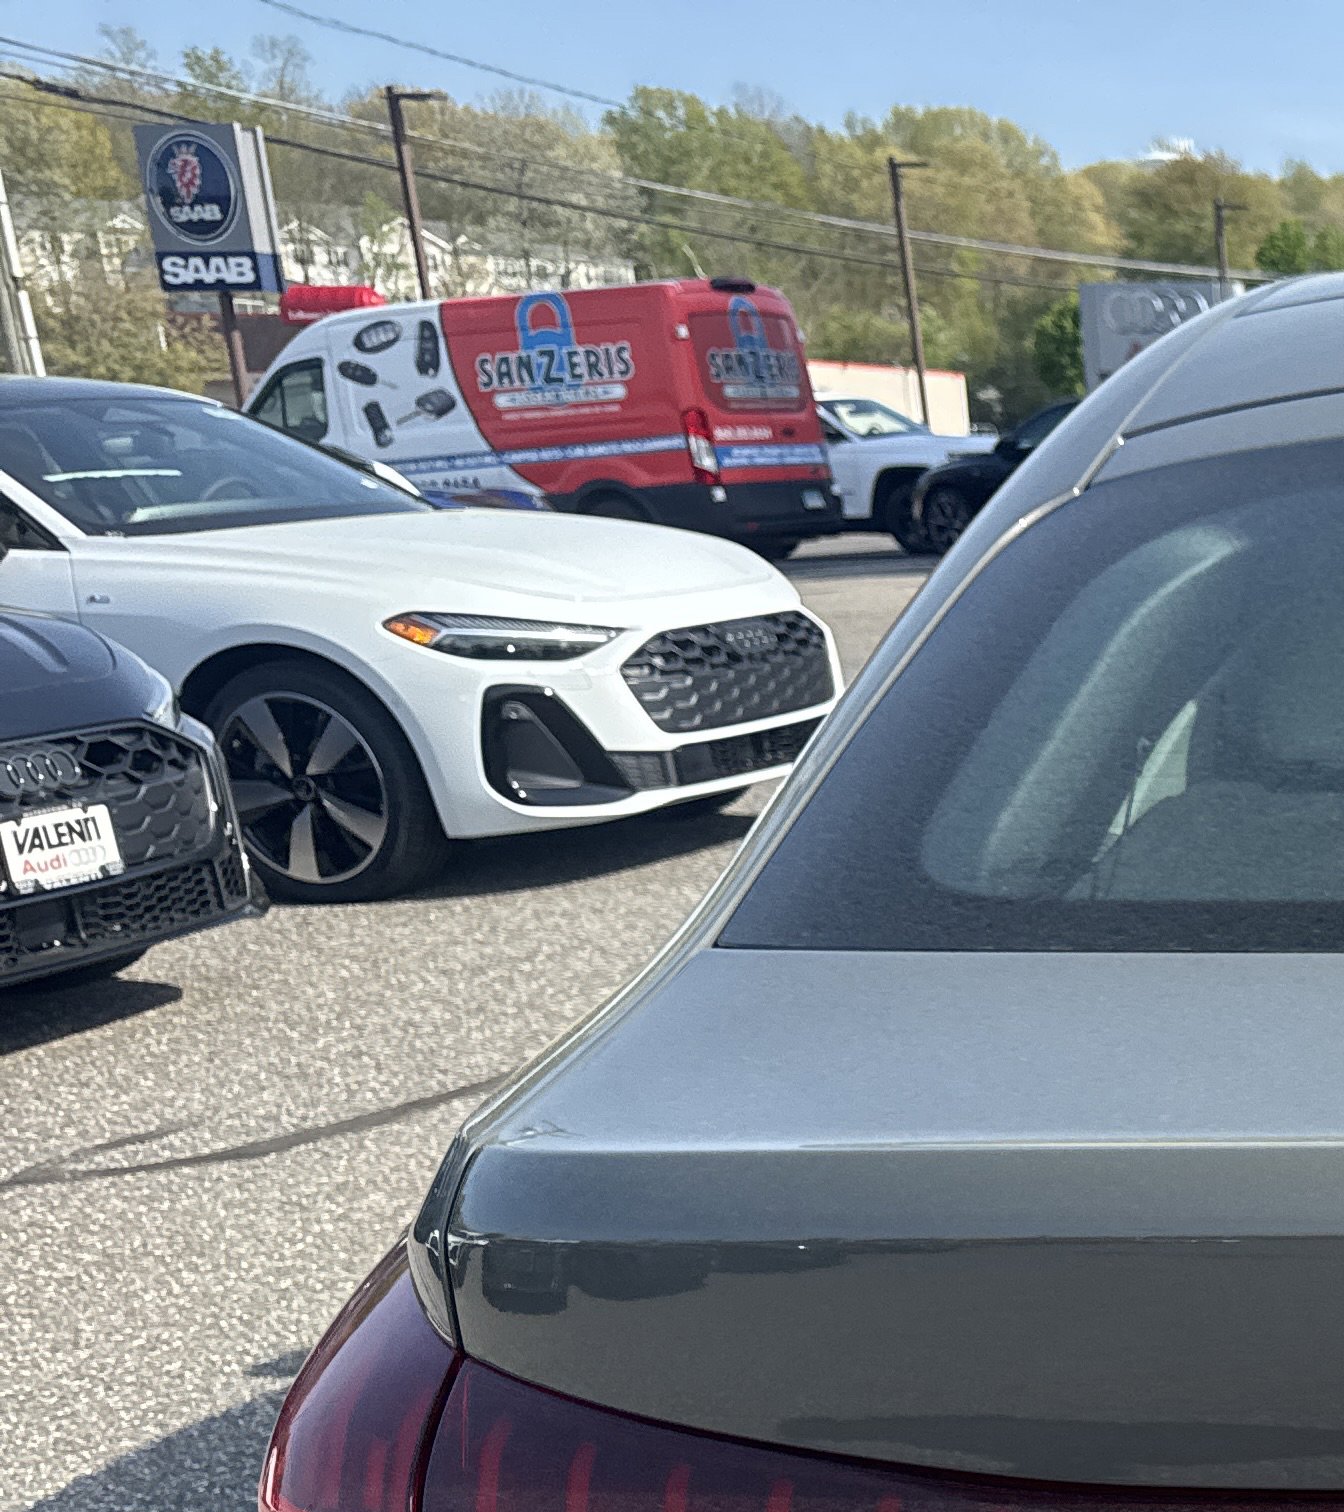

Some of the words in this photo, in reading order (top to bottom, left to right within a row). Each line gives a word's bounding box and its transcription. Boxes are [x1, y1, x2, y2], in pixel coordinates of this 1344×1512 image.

[170, 204, 223, 222] SAAB
[161, 256, 257, 284] SAAB
[12, 816, 101, 855] VALENTI
[23, 852, 67, 875] Audi
